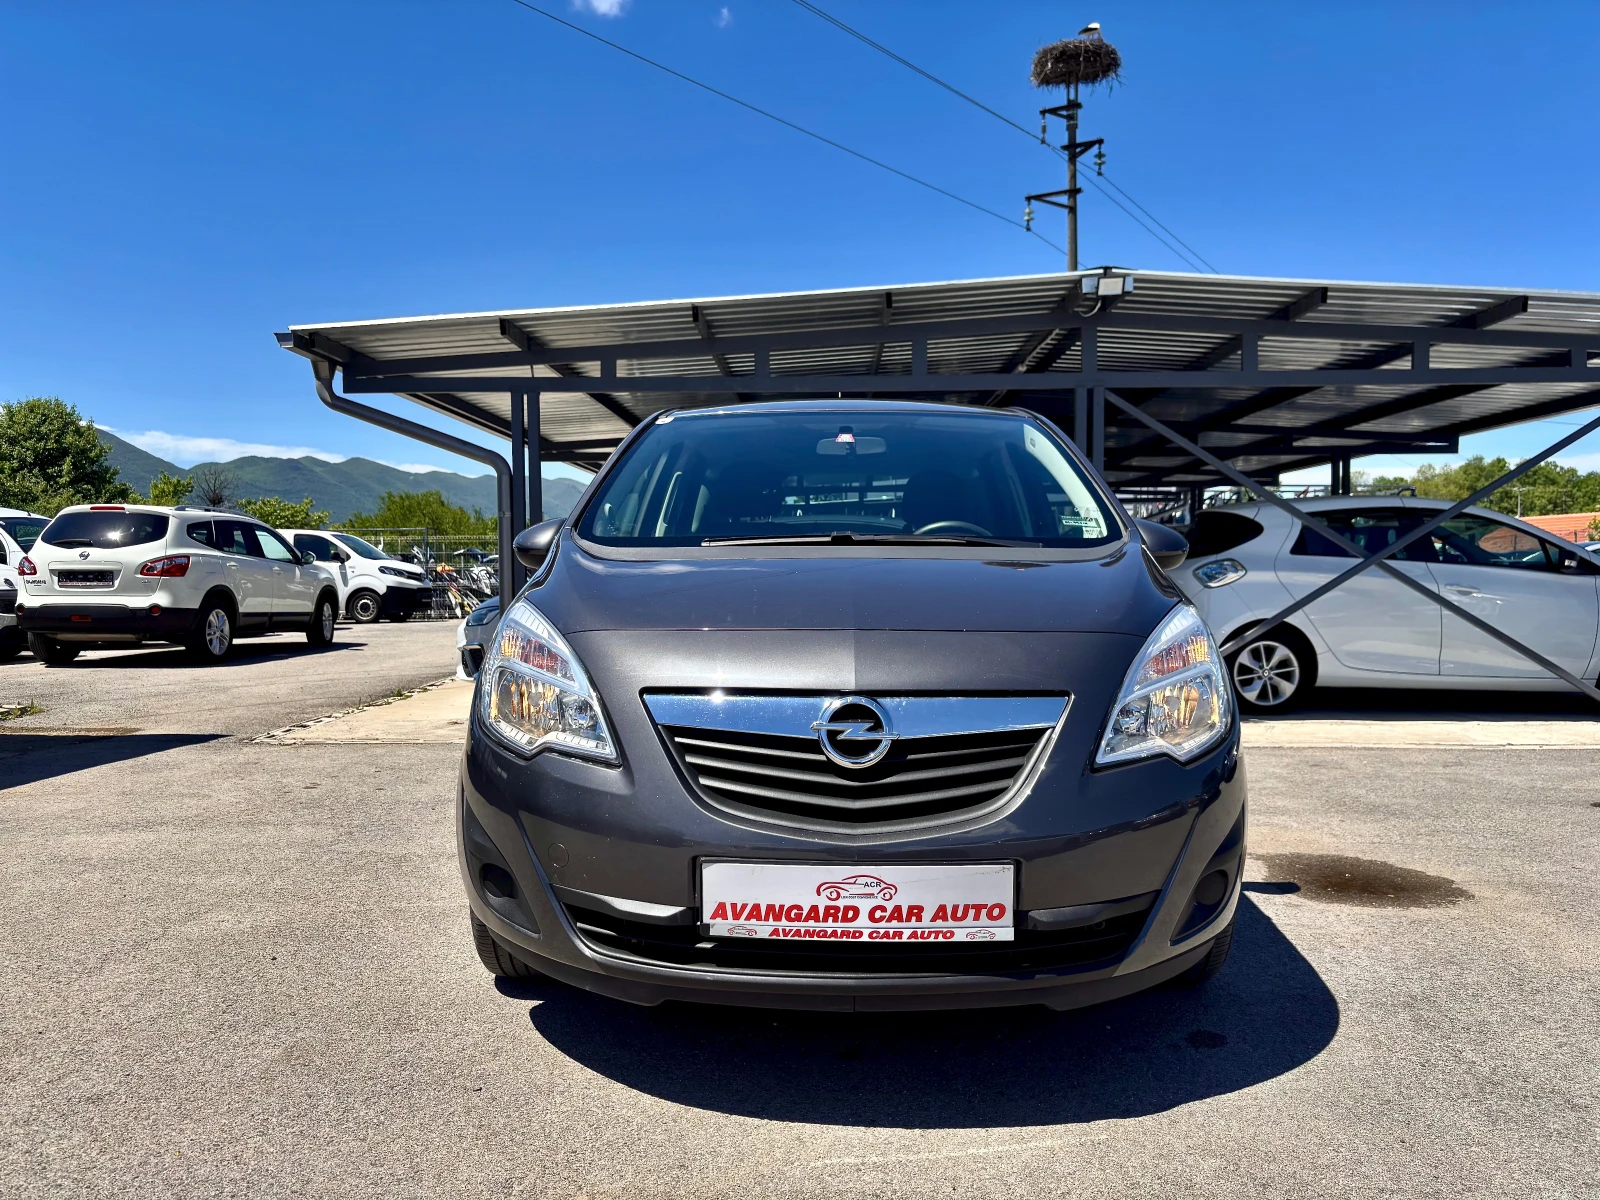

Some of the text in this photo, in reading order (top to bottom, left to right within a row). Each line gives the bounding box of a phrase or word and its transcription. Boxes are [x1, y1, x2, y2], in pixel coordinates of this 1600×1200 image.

[710, 902, 1007, 924] AVANGARD CAR AUTO
[768, 928, 956, 941] AVANGARD CAR AUTO
